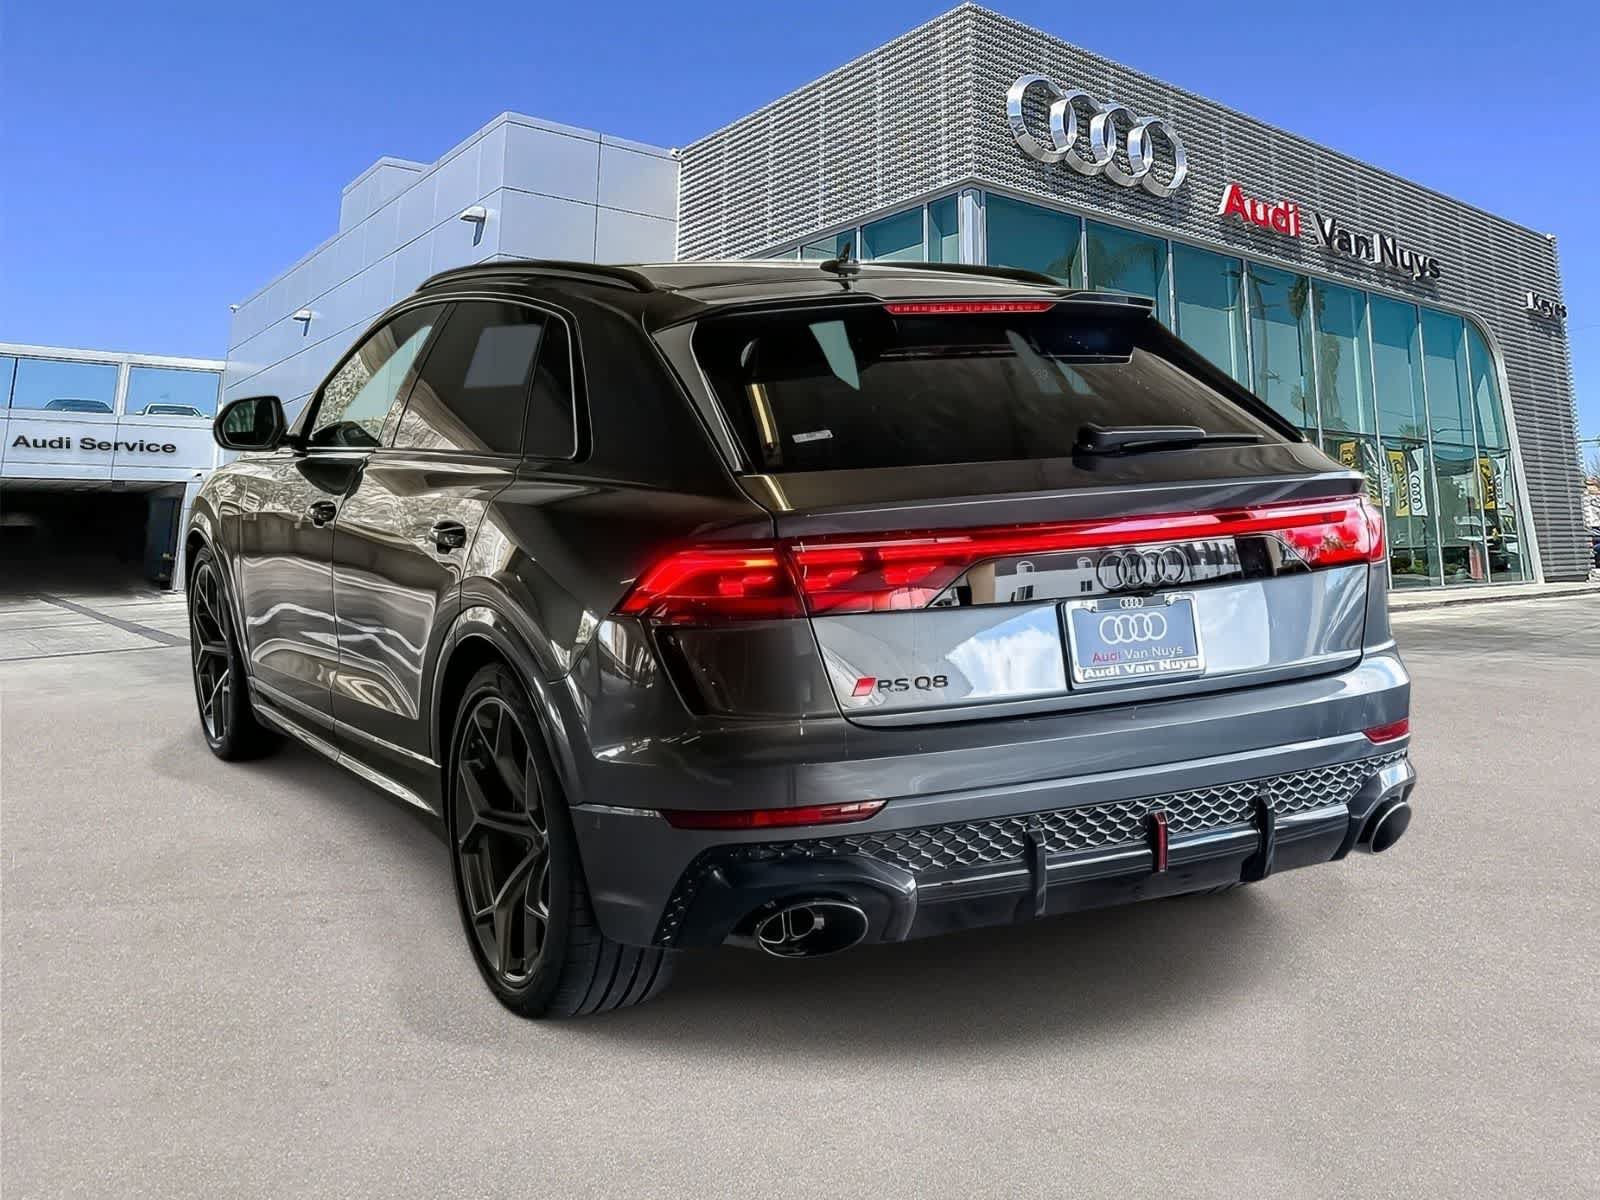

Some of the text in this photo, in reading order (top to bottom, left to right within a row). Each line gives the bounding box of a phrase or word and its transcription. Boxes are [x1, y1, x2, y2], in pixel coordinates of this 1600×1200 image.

[1217, 182, 1441, 281] Audi Van Nuys
[12, 435, 177, 453] Audi Service
[1092, 645, 1184, 663] Audi Van Nuys
[1084, 657, 1198, 679] Audi Van Nuys
[877, 675, 949, 693] RS Q8
